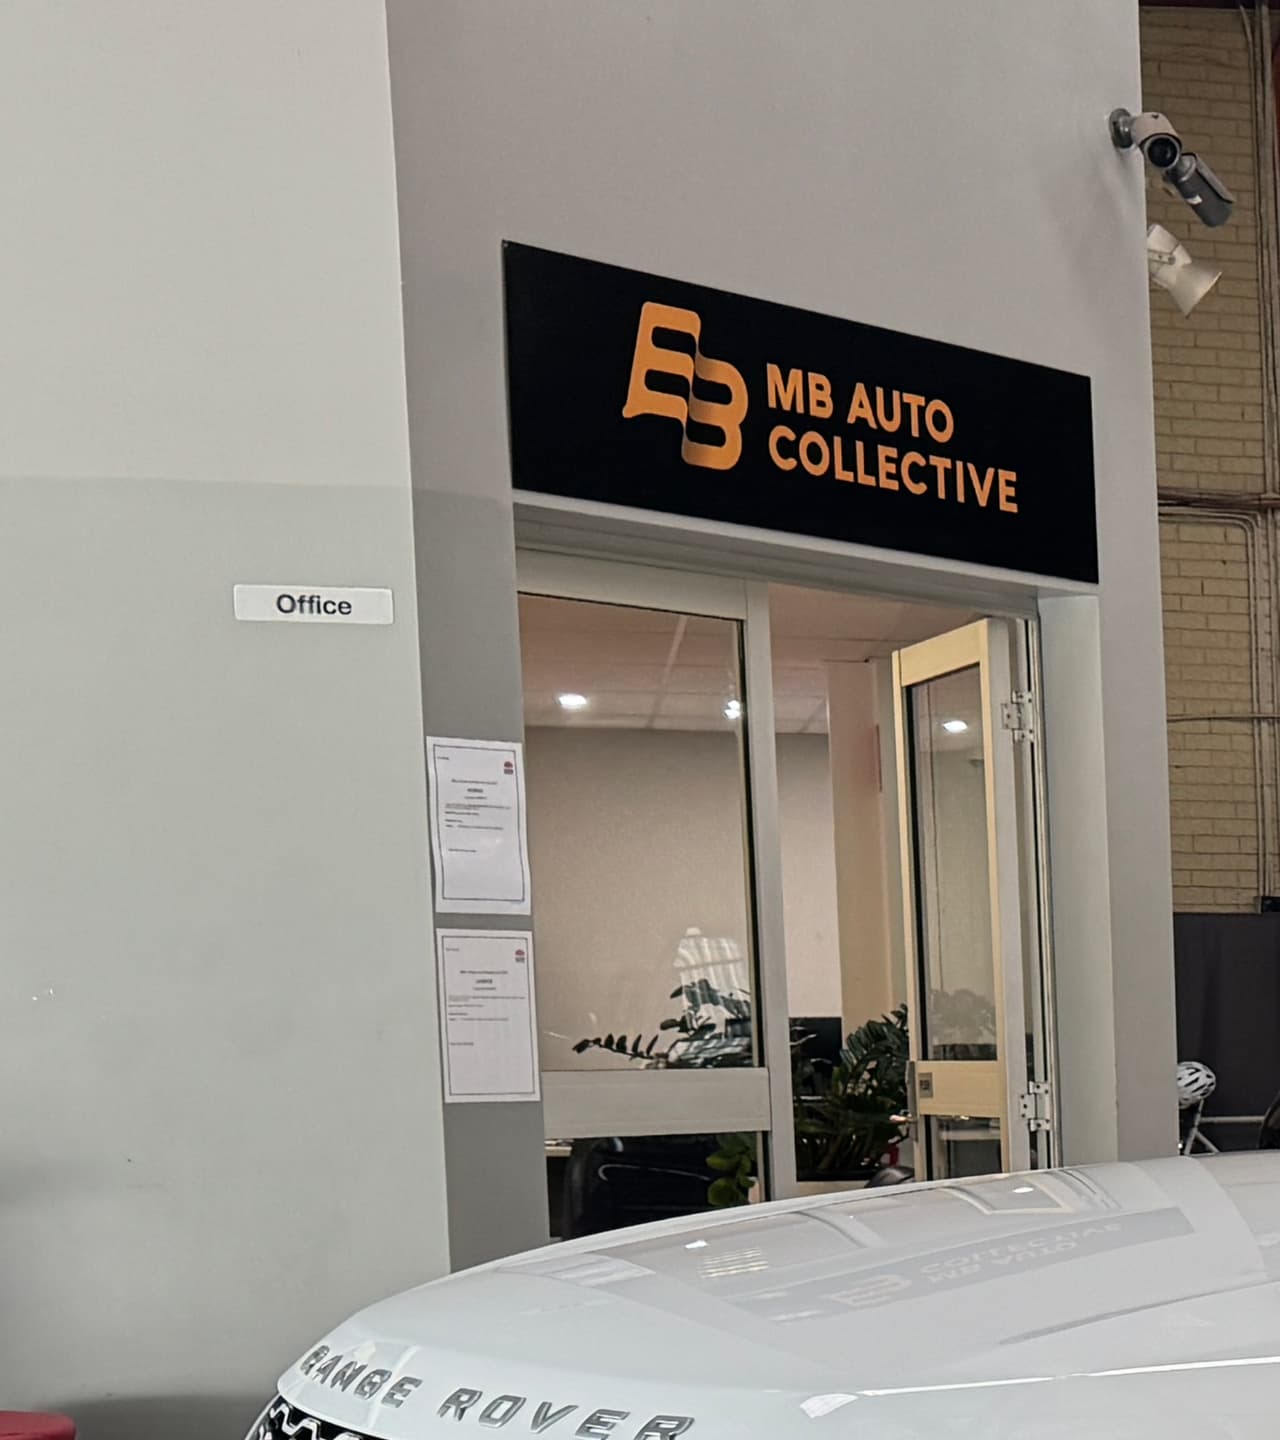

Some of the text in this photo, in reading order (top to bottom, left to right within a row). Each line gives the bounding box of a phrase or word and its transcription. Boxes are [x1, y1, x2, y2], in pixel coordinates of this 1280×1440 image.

[766, 362, 954, 443] MB AUTO
[768, 425, 1019, 513] COLLECTIVE
[276, 594, 352, 615] Office
[300, 1345, 423, 1409] RANGE
